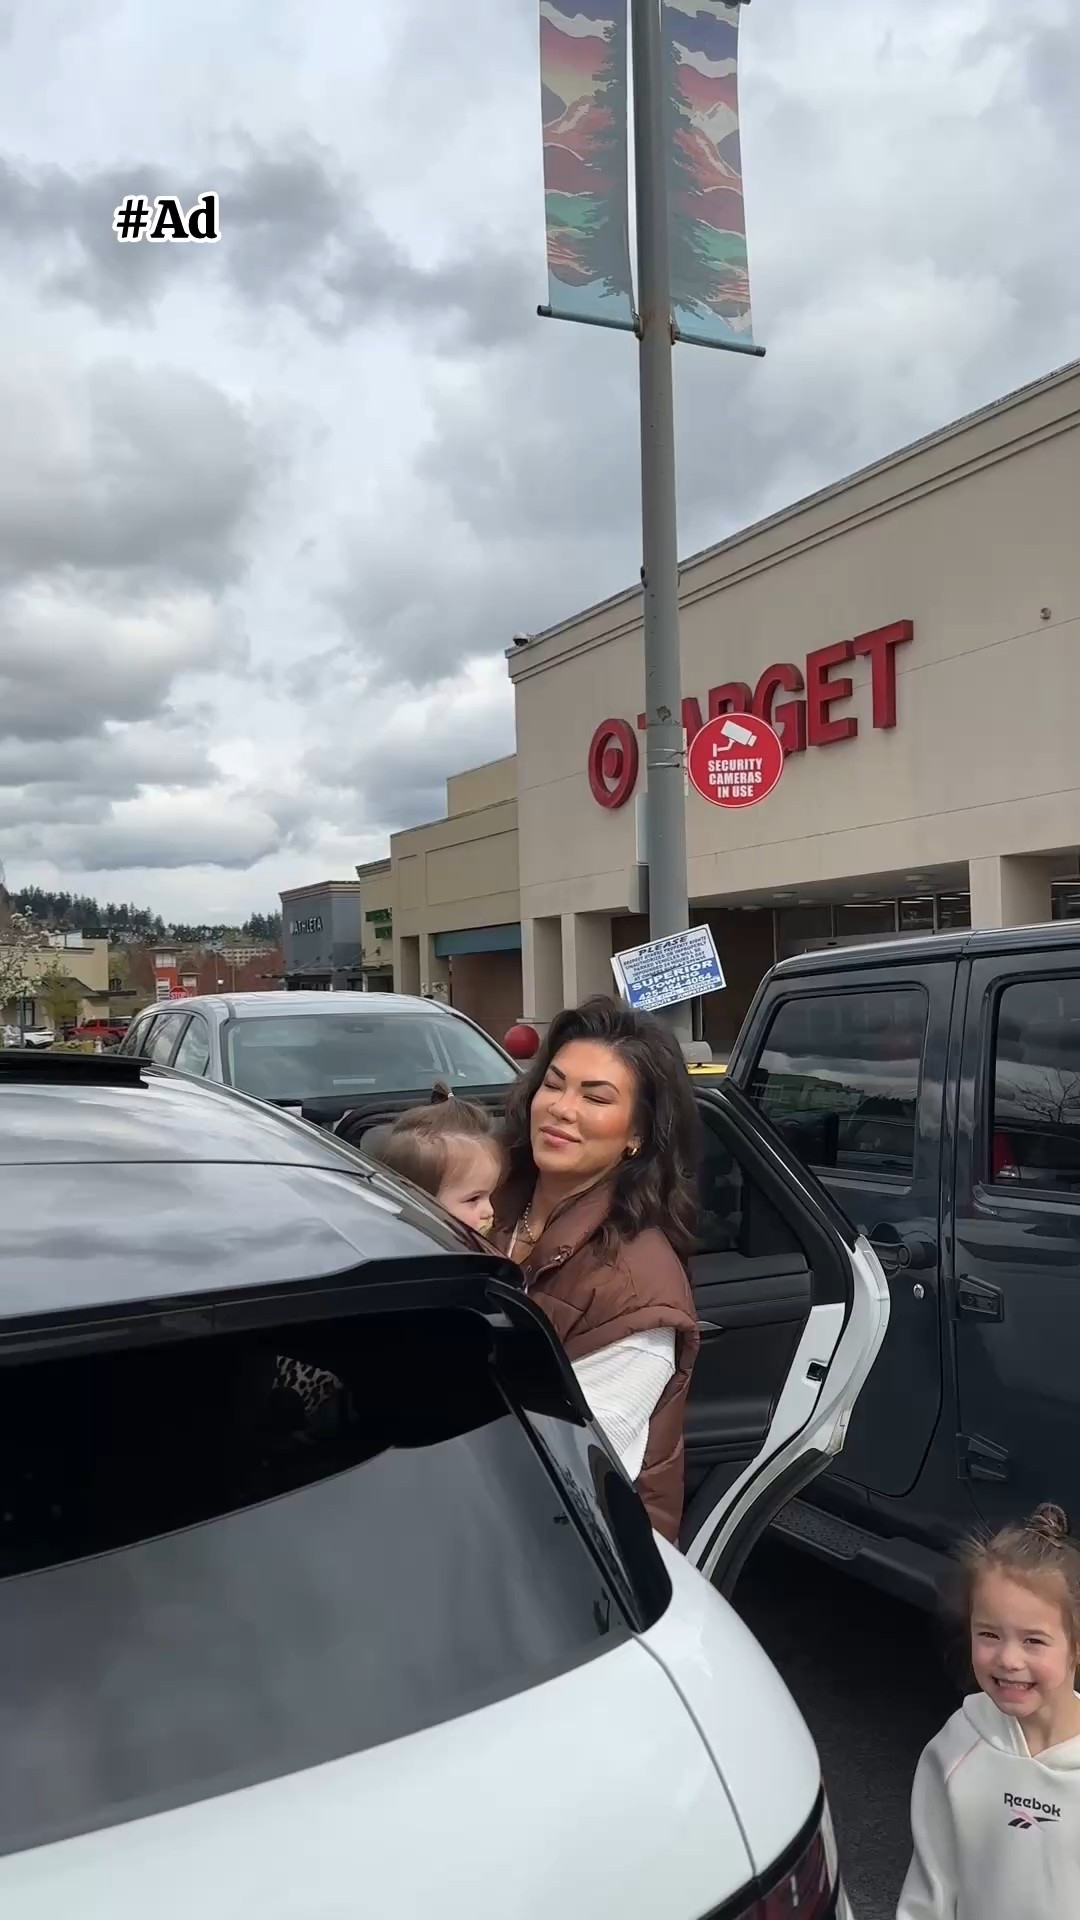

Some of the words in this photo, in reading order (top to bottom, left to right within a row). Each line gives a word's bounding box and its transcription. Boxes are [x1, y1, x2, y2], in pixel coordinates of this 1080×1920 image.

[708, 758, 762, 772] SECURITY
[709, 772, 762, 785] CAMERAS
[718, 786, 729, 798] IN
[732, 785, 753, 797] USE
[638, 935, 688, 956] PLEASE
[630, 958, 713, 991] SUPERIOR
[647, 970, 700, 991] TOWING
[637, 972, 712, 1001] 425-454-4054
[1004, 1793, 1061, 1817] Reebok
